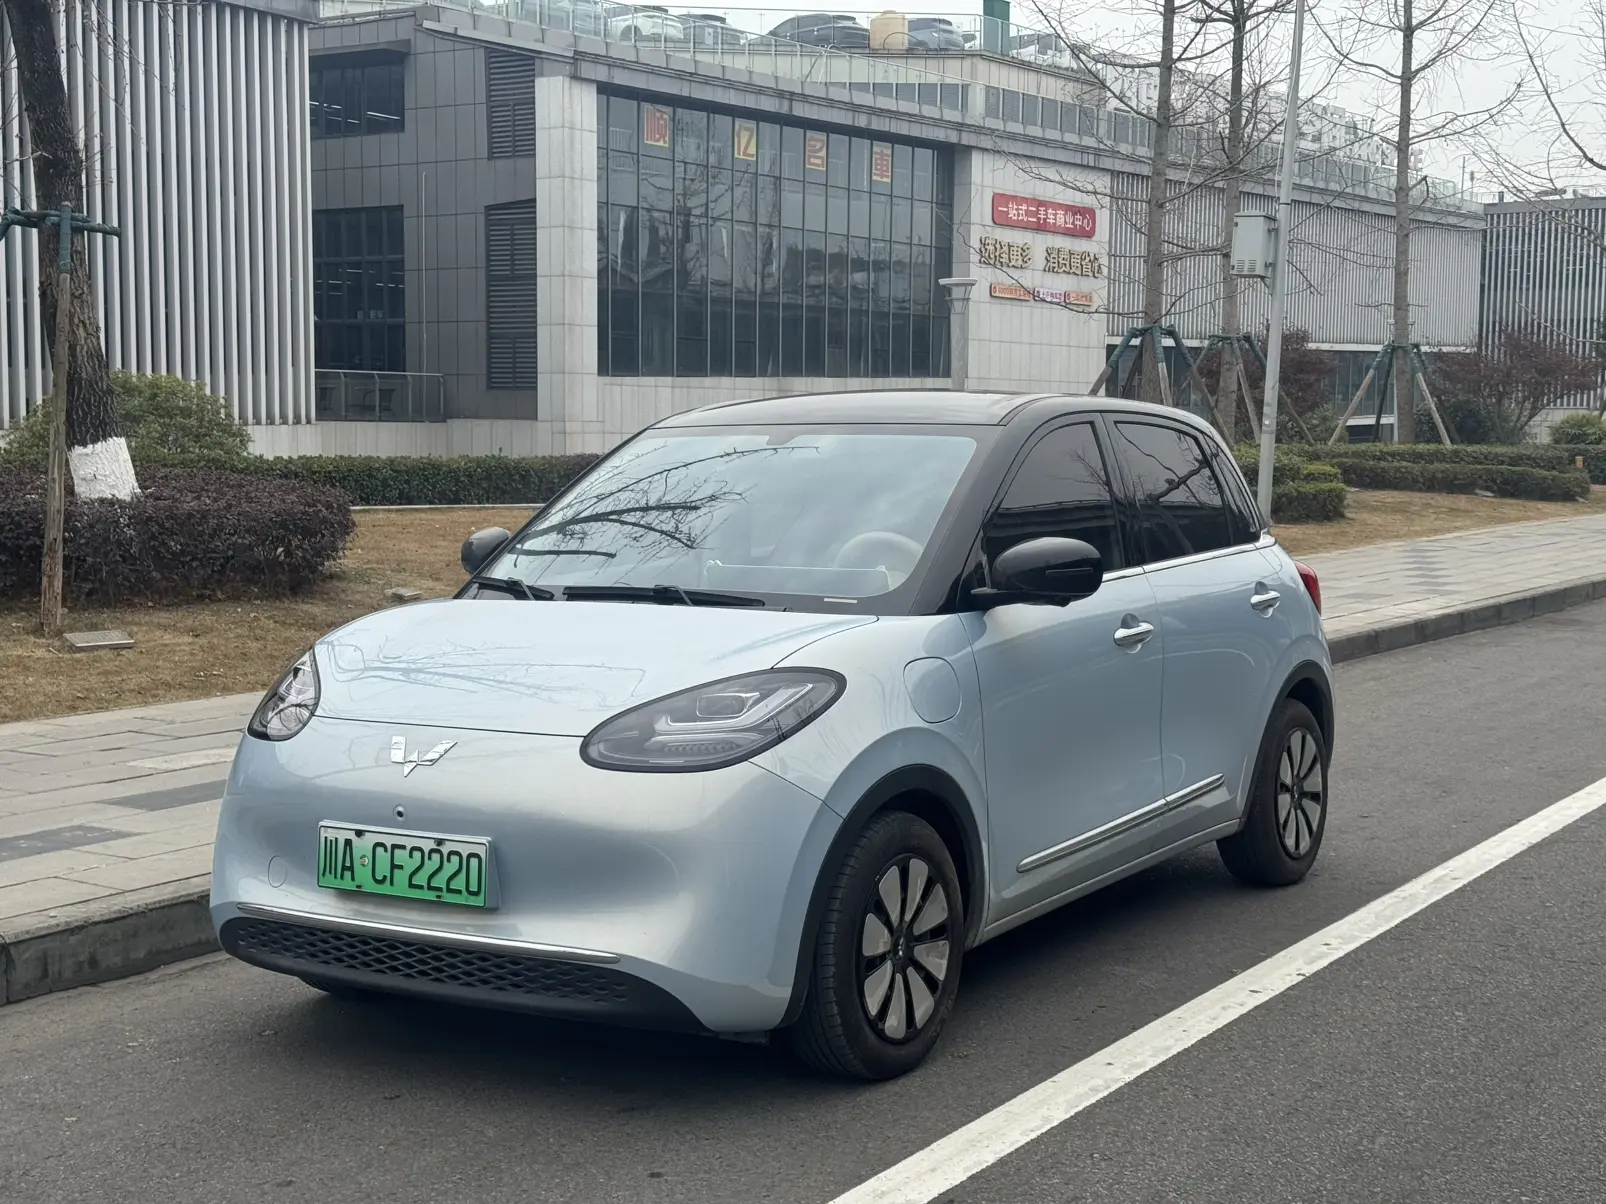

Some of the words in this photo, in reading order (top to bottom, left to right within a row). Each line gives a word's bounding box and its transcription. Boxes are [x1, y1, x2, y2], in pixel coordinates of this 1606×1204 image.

[645, 106, 668, 145] 顺
[735, 124, 756, 159] 亿
[997, 201, 1093, 231] 一站式二手车商业中心
[979, 236, 1033, 269] 选择更多
[1044, 246, 1104, 278] 消费更省心
[321, 835, 355, 882] 川A
[371, 841, 483, 897] CF2220
